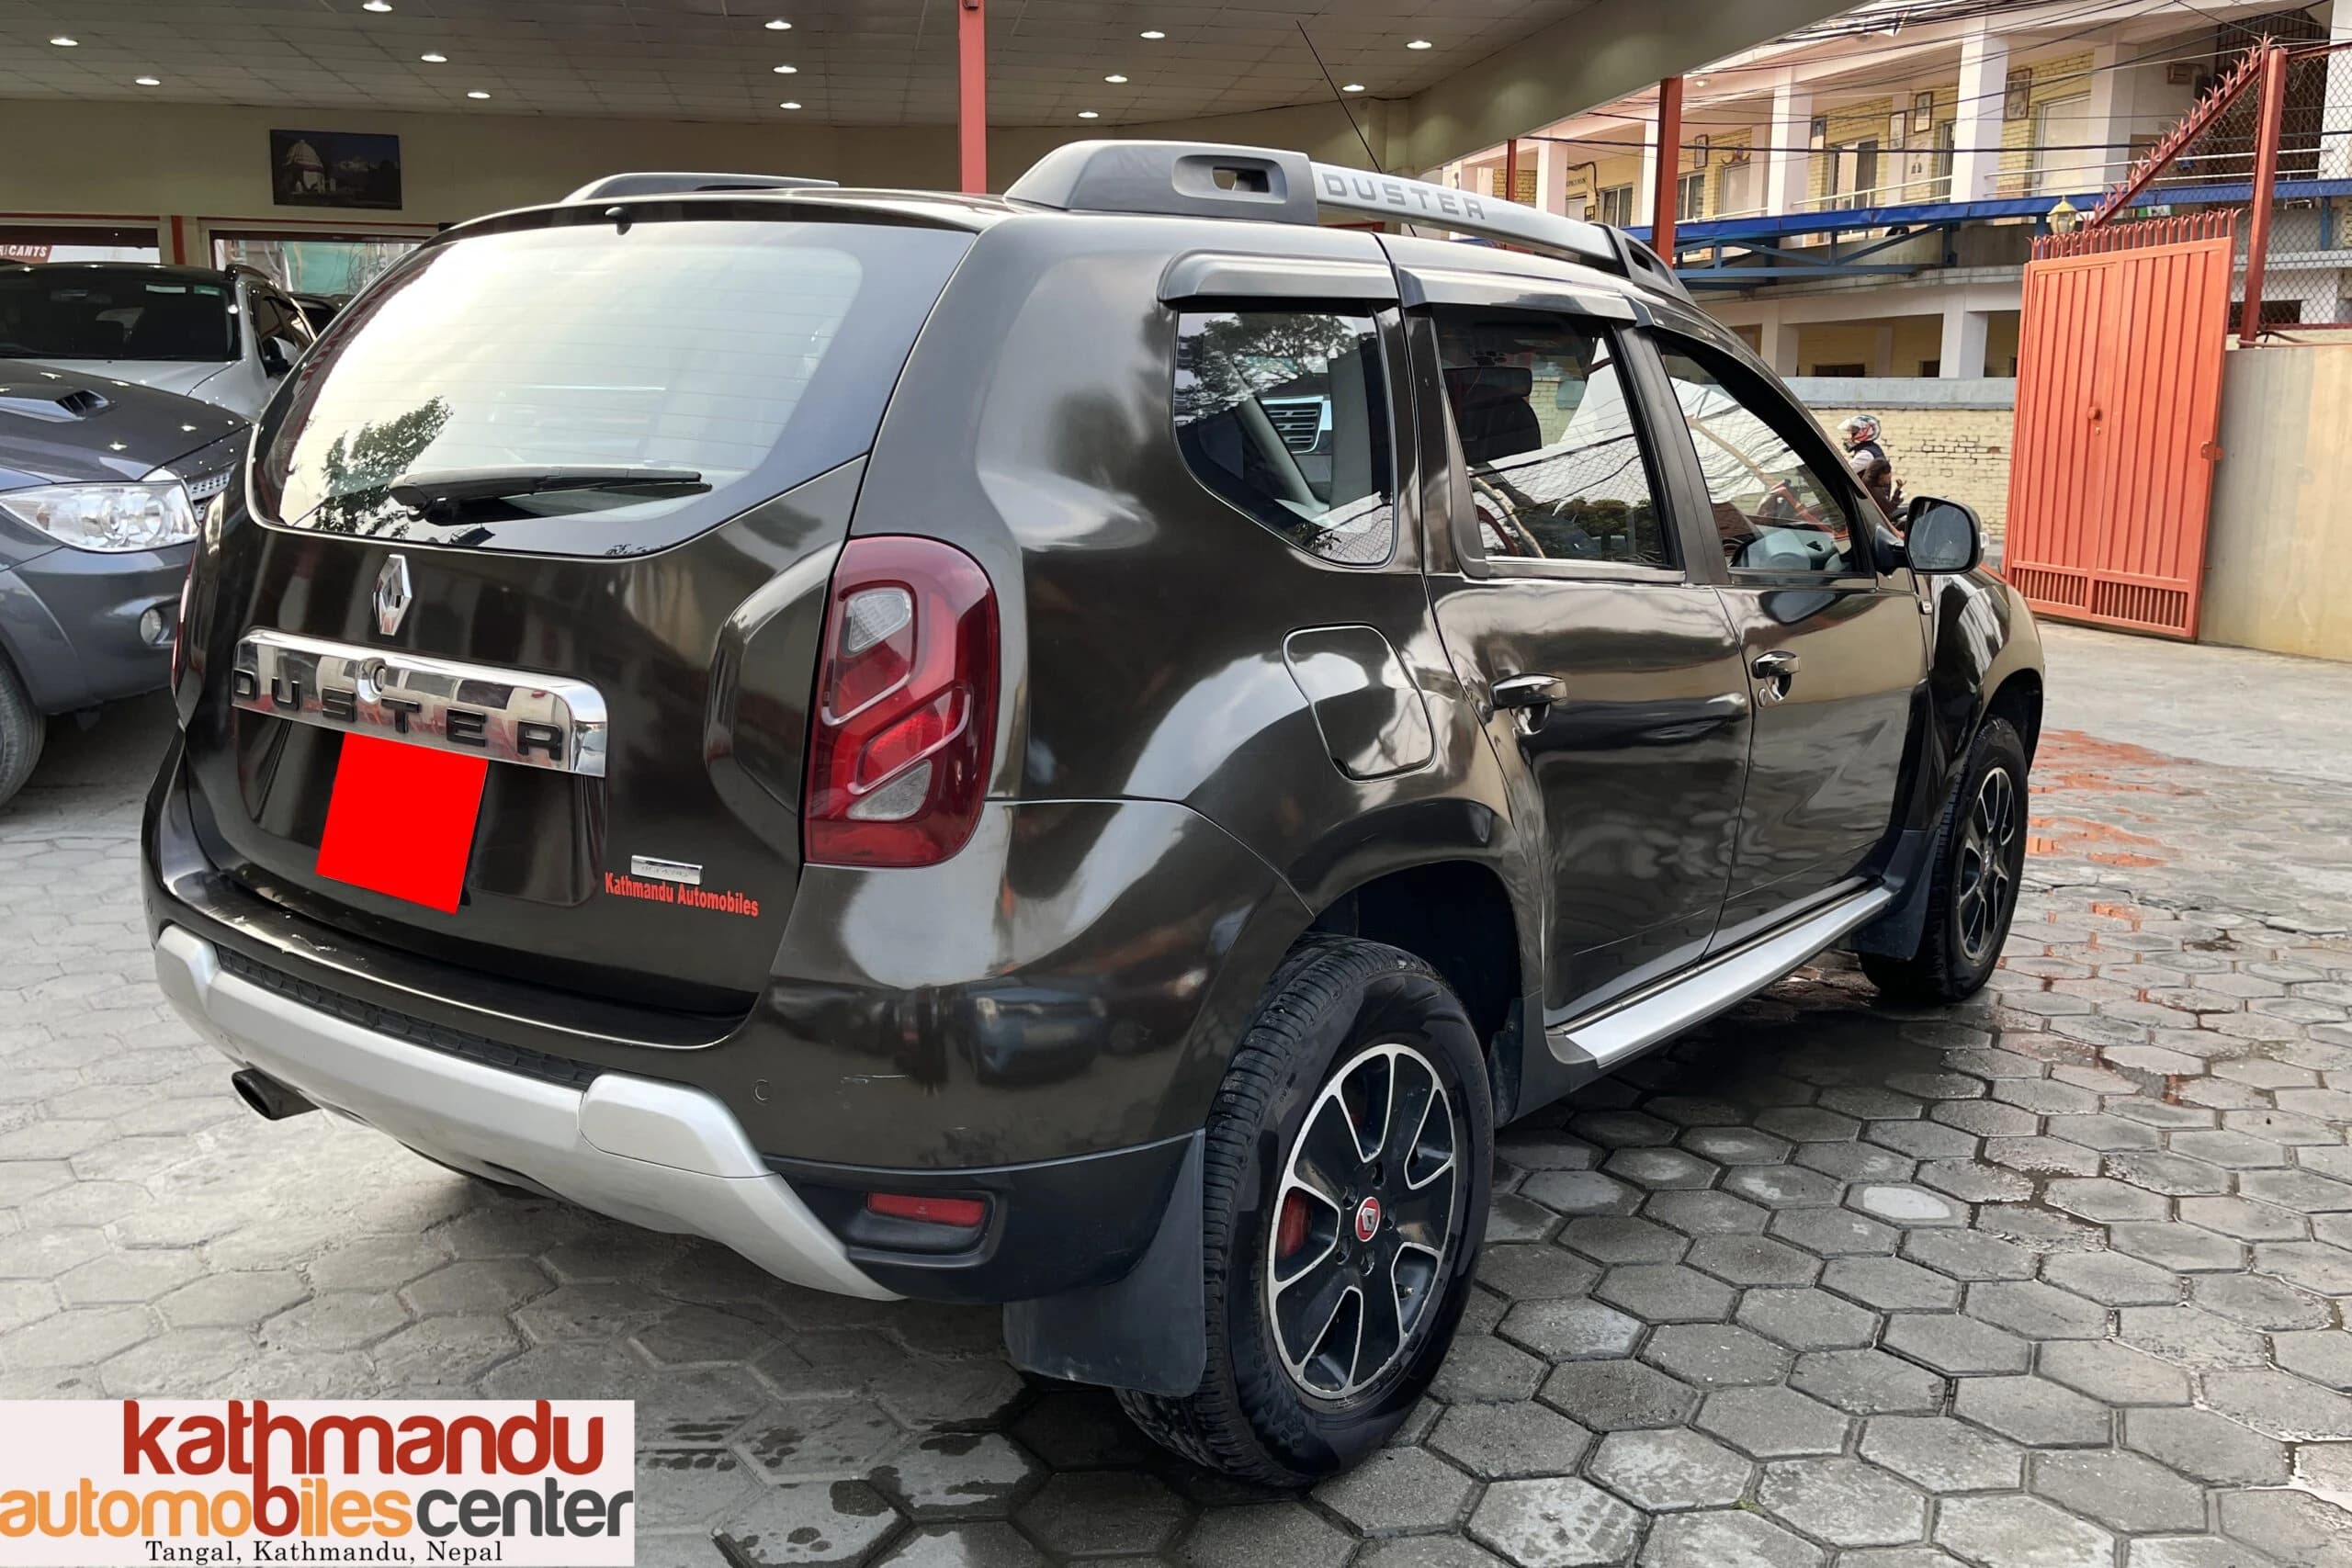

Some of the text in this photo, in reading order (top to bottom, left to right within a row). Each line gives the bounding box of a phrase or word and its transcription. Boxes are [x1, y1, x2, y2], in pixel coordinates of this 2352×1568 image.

[1321, 172, 1487, 221] DUSTER
[232, 667, 563, 761] DUSTER
[605, 872, 760, 918] Kathmandu Automobiles
